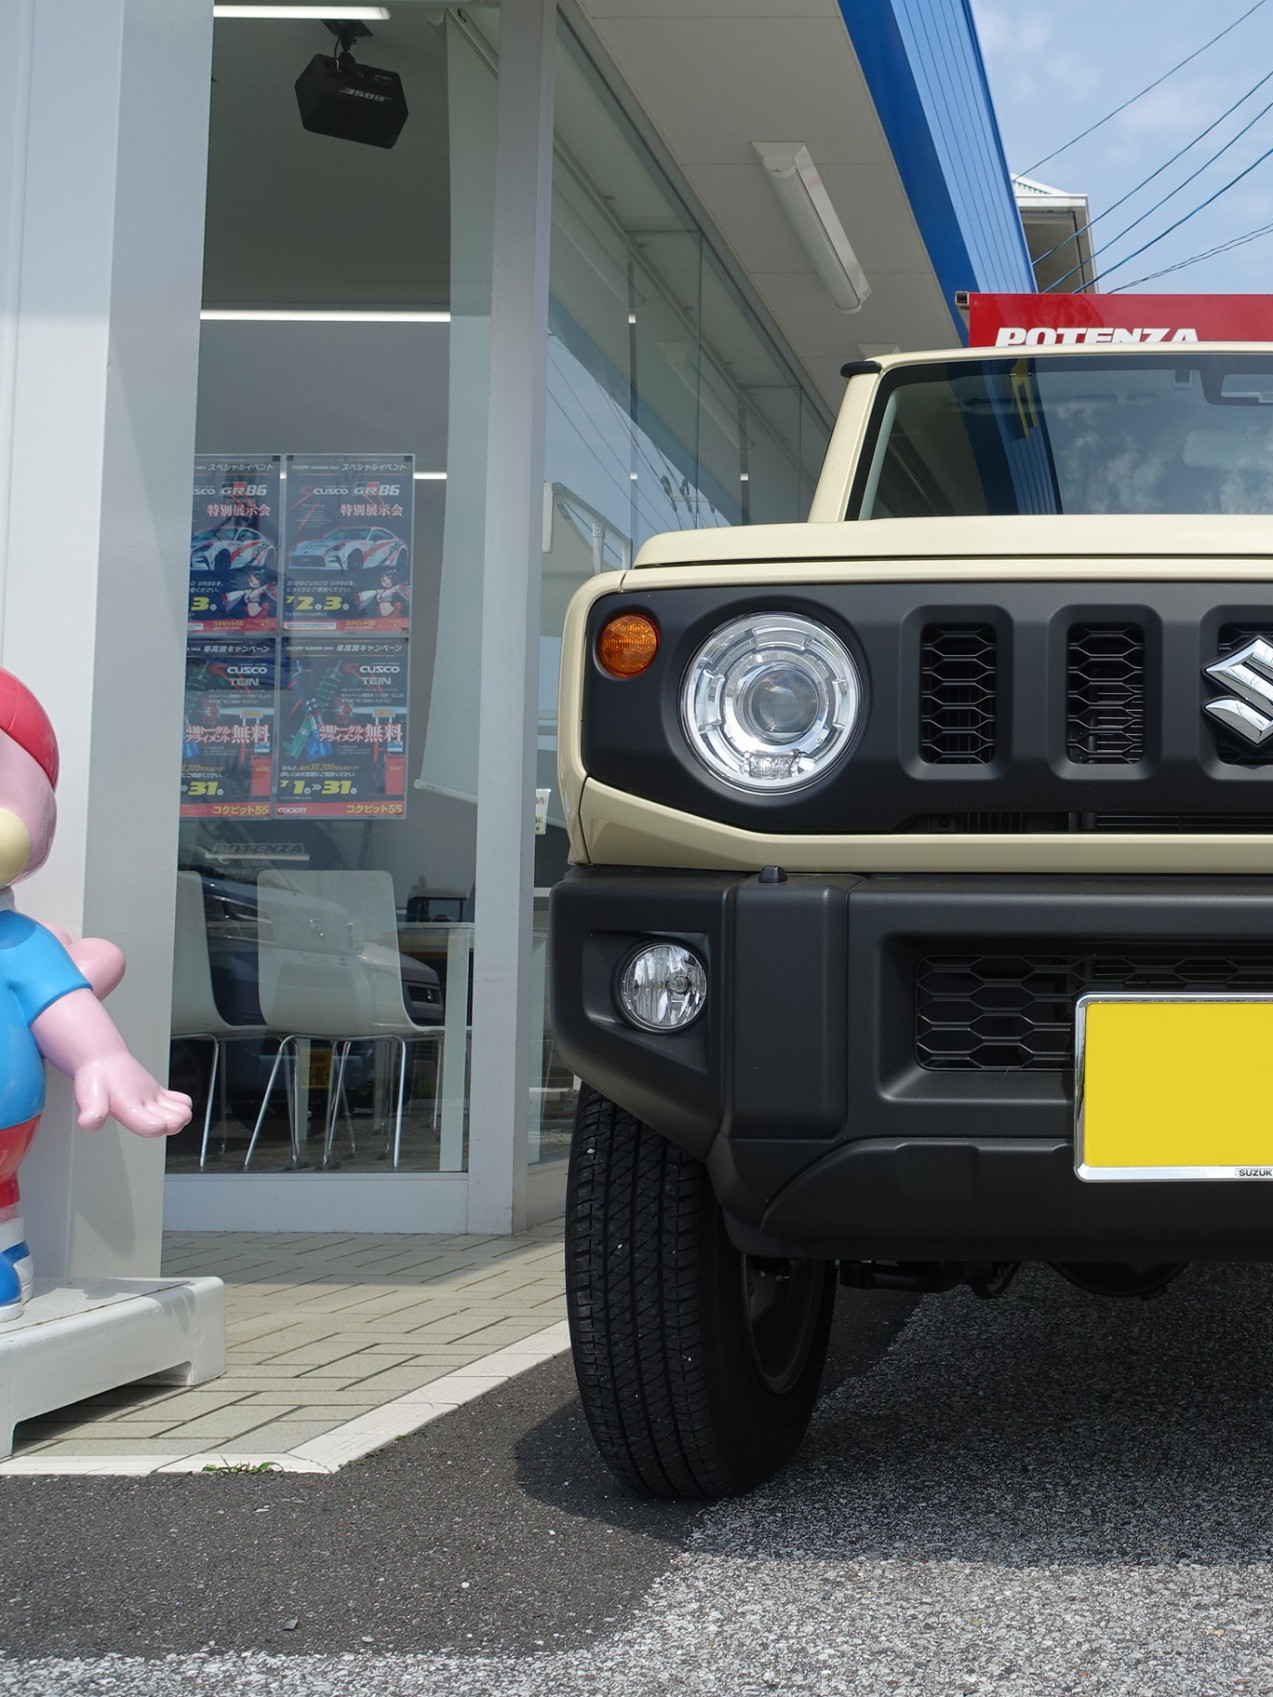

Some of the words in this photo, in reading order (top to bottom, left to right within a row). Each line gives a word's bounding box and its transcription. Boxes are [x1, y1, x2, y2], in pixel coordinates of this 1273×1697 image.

[206, 503, 271, 517] 特別展示会
[340, 503, 404, 517] 特別展示会
[227, 666, 268, 674] CUSCO
[359, 665, 400, 673] CUSCO
[231, 724, 270, 743] 無料
[364, 723, 403, 742] 無料
